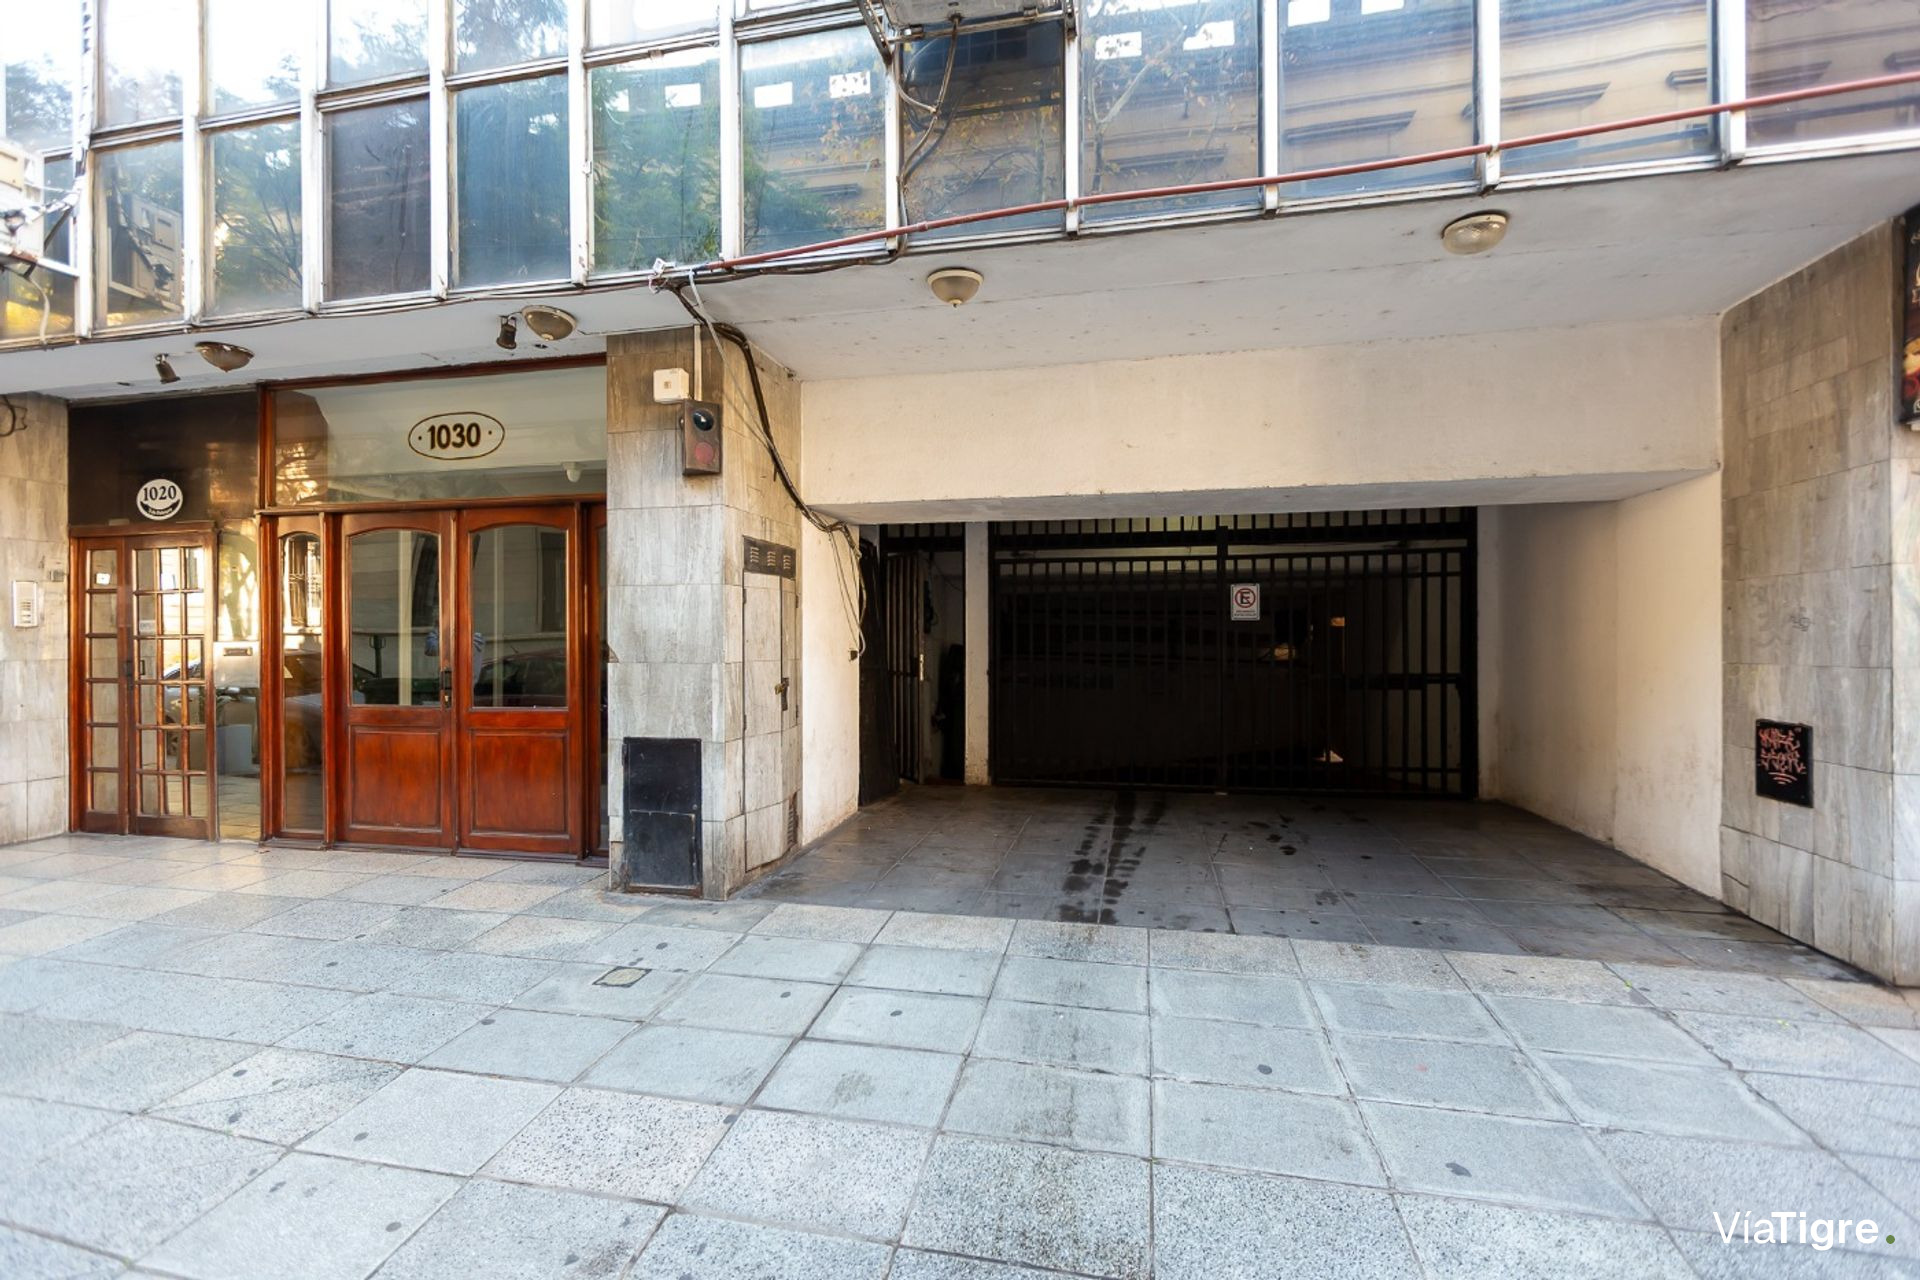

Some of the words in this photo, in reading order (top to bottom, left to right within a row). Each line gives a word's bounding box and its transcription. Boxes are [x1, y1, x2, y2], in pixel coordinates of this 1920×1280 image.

[427, 422, 481, 449] 1030
[143, 485, 177, 501] 1020
[1240, 591, 1251, 604] E
